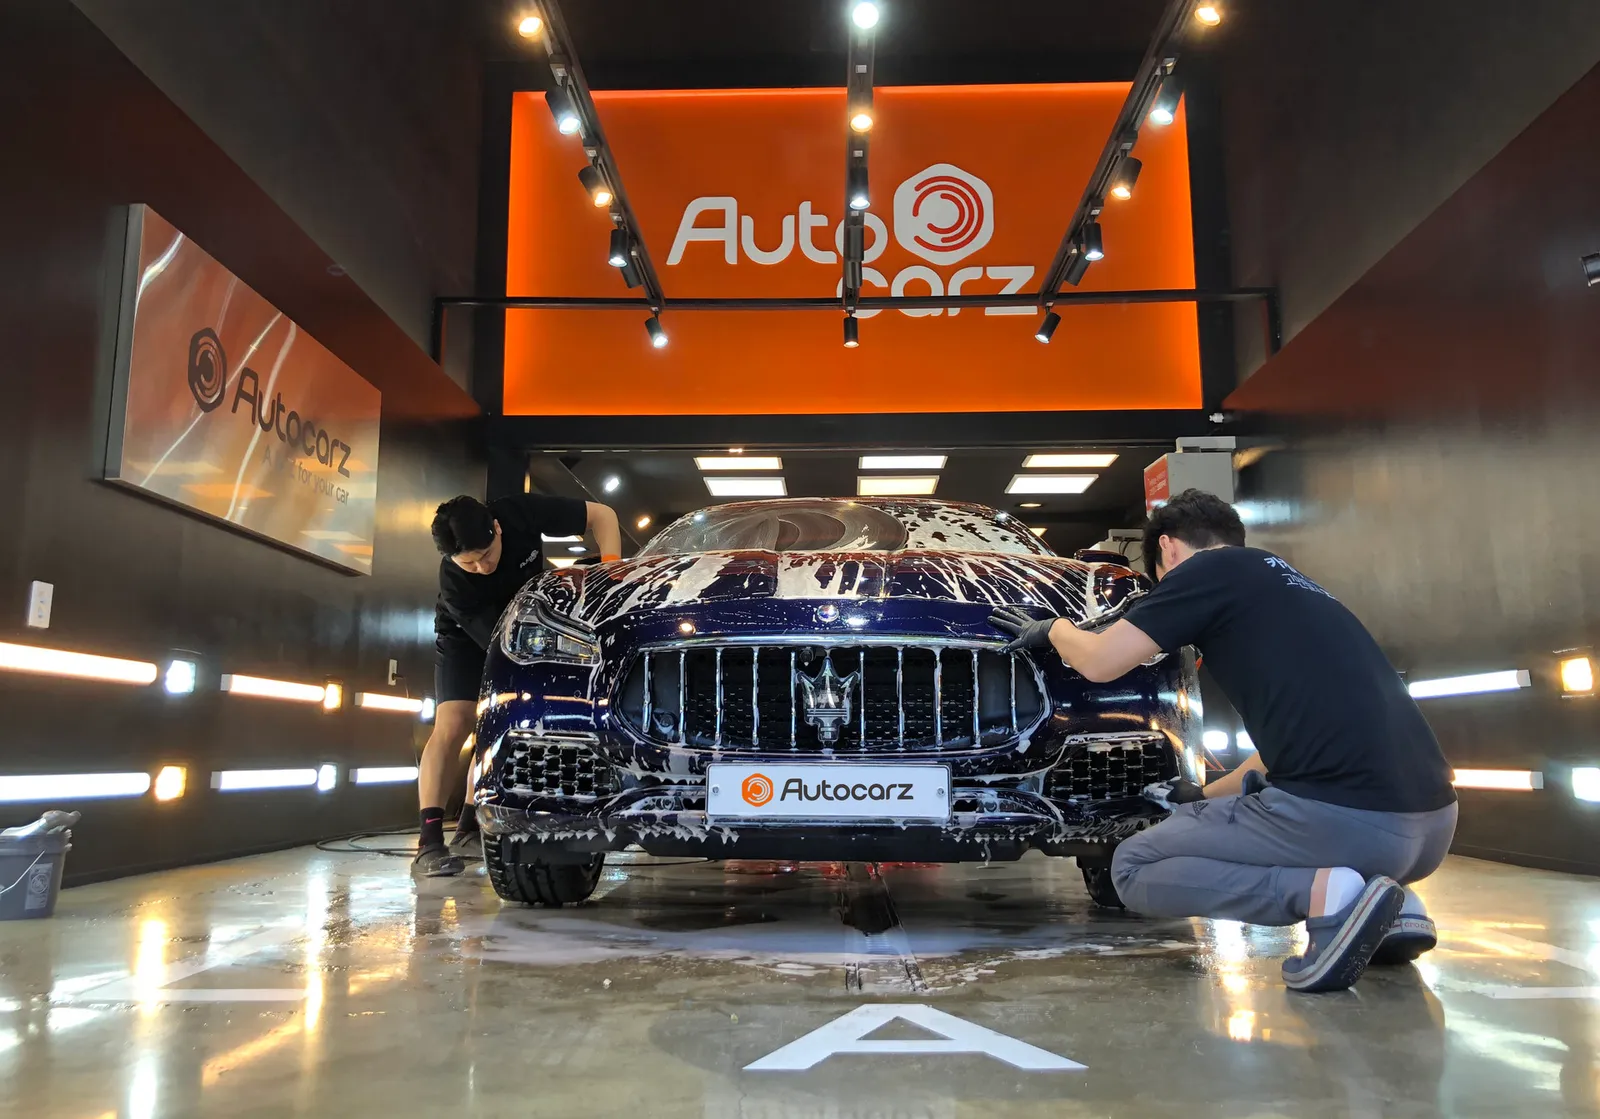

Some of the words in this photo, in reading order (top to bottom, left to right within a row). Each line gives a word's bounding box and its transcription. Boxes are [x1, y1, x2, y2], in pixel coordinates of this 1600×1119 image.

[666, 196, 888, 265] Auto
[836, 265, 1038, 319] carz
[231, 367, 351, 478] Autocarz
[298, 461, 312, 485] for
[314, 474, 335, 497] your
[336, 486, 350, 506] car
[780, 778, 914, 801] Autocarz
